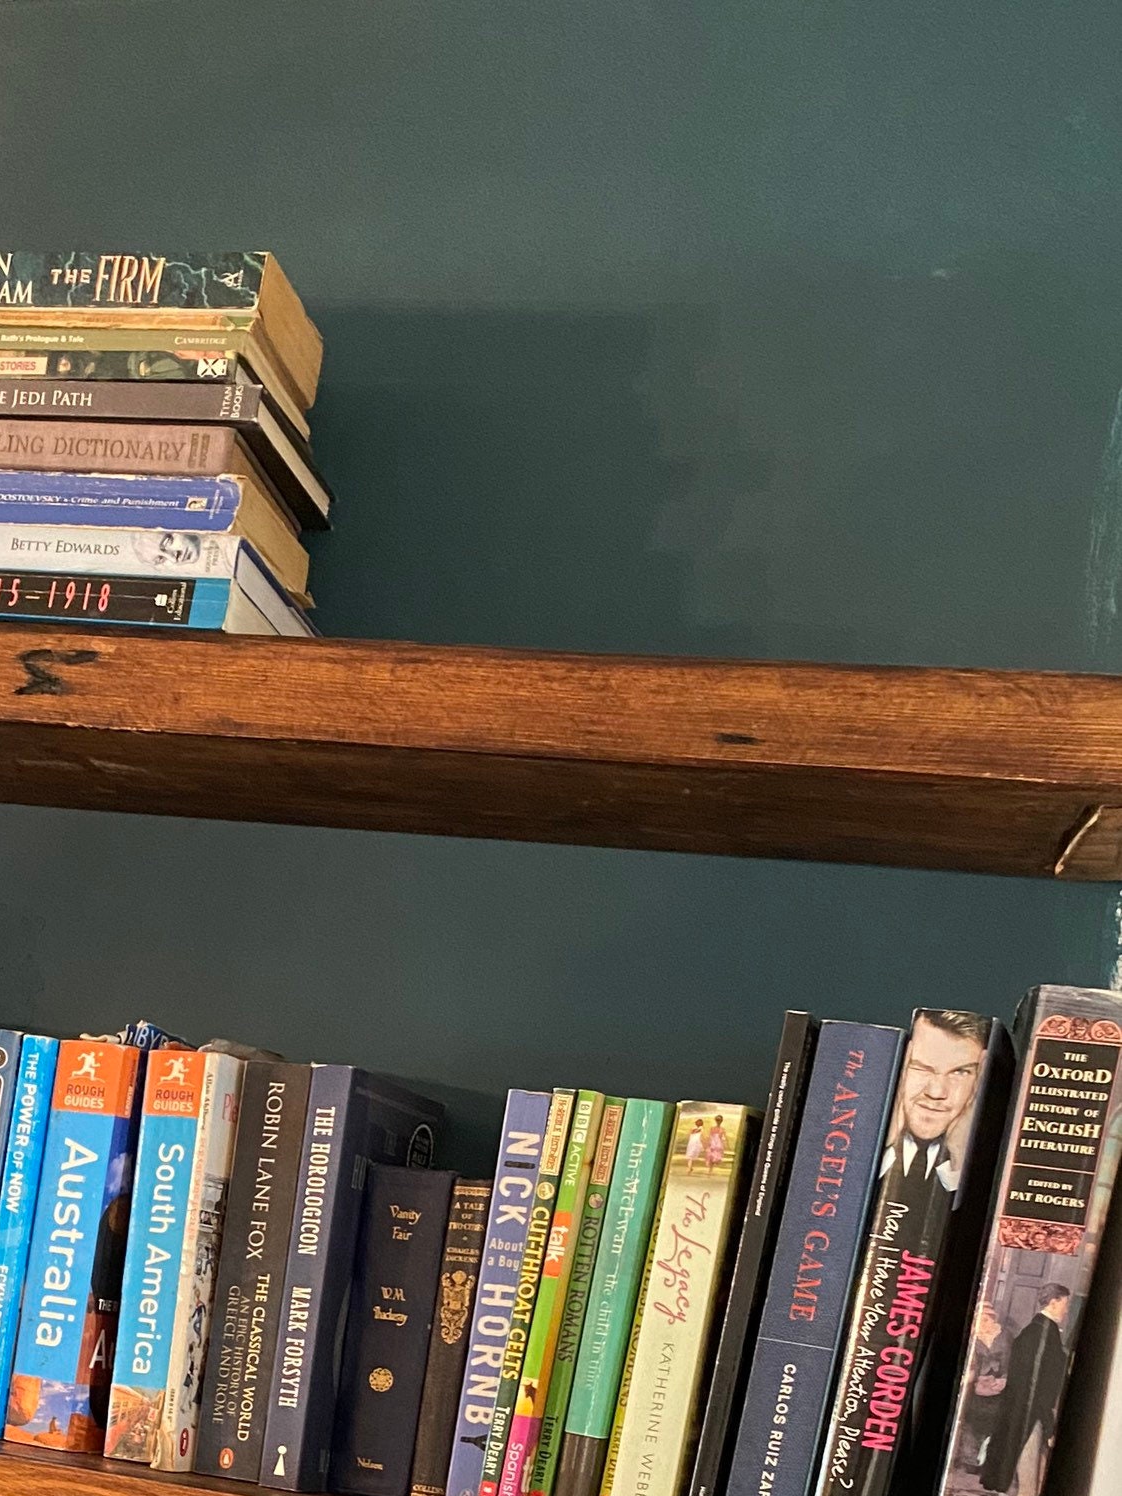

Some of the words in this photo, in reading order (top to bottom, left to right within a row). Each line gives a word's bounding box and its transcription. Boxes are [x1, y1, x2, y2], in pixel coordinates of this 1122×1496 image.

[50, 268, 92, 285] THE
[92, 254, 165, 304] FIRM
[0, 361, 37, 372] STORIES
[11, 390, 46, 406] JEDI
[52, 390, 93, 407] PATH
[220, 386, 231, 418] TITAN
[231, 384, 245, 419] BOOKS
[53, 436, 187, 462] DICTIONARY
[10, 537, 52, 552] BETTY
[56, 540, 120, 556] EDWARDS
[24, 1052, 40, 1080] THE
[1033, 1062, 1113, 1085] OXFORD
[1063, 1052, 1089, 1063] THE
[64, 1096, 105, 1109] GUIDES
[66, 1083, 106, 1097] ROUGH
[153, 1100, 194, 1112] GUIDES
[155, 1089, 194, 1101] ROUGH
[1029, 1085, 1109, 1102] ILLUSTRATED
[14, 1083, 37, 1147] POWER
[260, 1081, 286, 1149] ROBIN
[312, 1106, 336, 1137] THE
[1021, 1116, 1102, 1139] ENGLISH
[1029, 1102, 1079, 1117] HISTORY
[1084, 1108, 1100, 1118] OF
[14, 1151, 25, 1170] OF
[564, 1144, 582, 1187] ACTIVE
[1020, 1138, 1096, 1156] LITERATURE
[5, 1171, 23, 1213] NOW
[148, 1142, 185, 1234] South
[252, 1157, 276, 1213] LANE
[495, 1131, 542, 1226] NICK
[297, 1142, 331, 1256] HOROLOGICON
[389, 1204, 422, 1225] Vanity
[1010, 1190, 1034, 1202] PAT
[1034, 1193, 1086, 1209] ROGERS
[35, 1136, 99, 1347] Australia
[245, 1220, 267, 1261] FOX
[392, 1226, 413, 1241] Fair
[489, 1237, 526, 1252] About
[544, 1224, 569, 1263] talk
[573, 1215, 599, 1282] ROTTEN
[513, 1205, 550, 1324] CUT-THROAT
[254, 1273, 271, 1303] THE
[886, 1249, 936, 1339] JAMES
[131, 1242, 172, 1375] America
[287, 1286, 312, 1332] MARK
[558, 1285, 584, 1364] ROMANS
[244, 1306, 266, 1383] CLASSICAL
[502, 1328, 527, 1381] CELTS
[278, 1337, 305, 1409] FORSYTH
[460, 1283, 516, 1452] HORNBY
[644, 1341, 675, 1444] KATHERINE
[772, 1363, 797, 1426] CARLOS
[861, 1346, 914, 1452] CORDEN
[236, 1385, 256, 1442] WORLD
[764, 1429, 784, 1468] RUIZ
